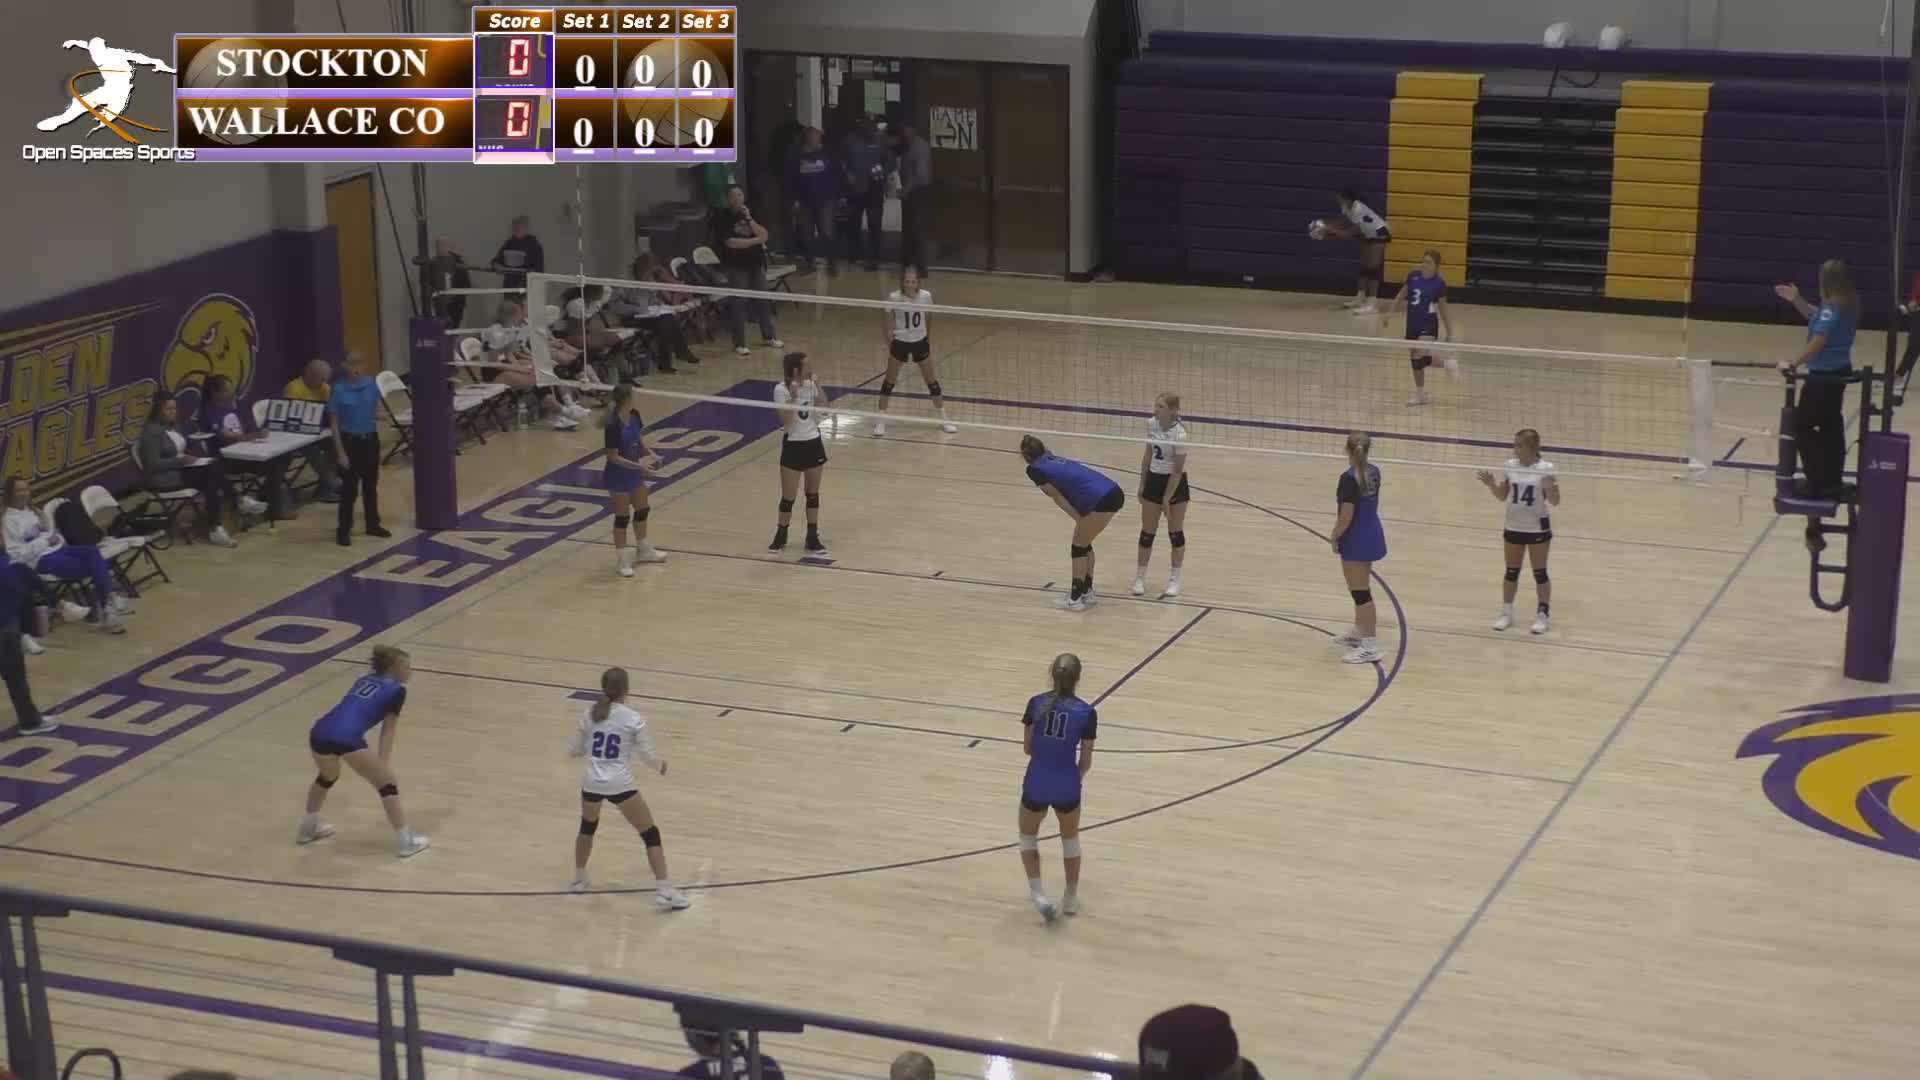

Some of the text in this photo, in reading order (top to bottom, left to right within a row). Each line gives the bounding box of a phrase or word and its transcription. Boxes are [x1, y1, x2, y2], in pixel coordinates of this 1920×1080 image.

[1410, 288, 1422, 306] 3
[904, 311, 921, 328] 10
[0, 325, 115, 421] DEN
[0, 378, 158, 480] AGLES
[1153, 445, 1165, 461] 2
[1511, 482, 1536, 507] 14
[0, 614, 364, 816] REGO
[1044, 710, 1069, 740] 11
[591, 731, 621, 759] 26
